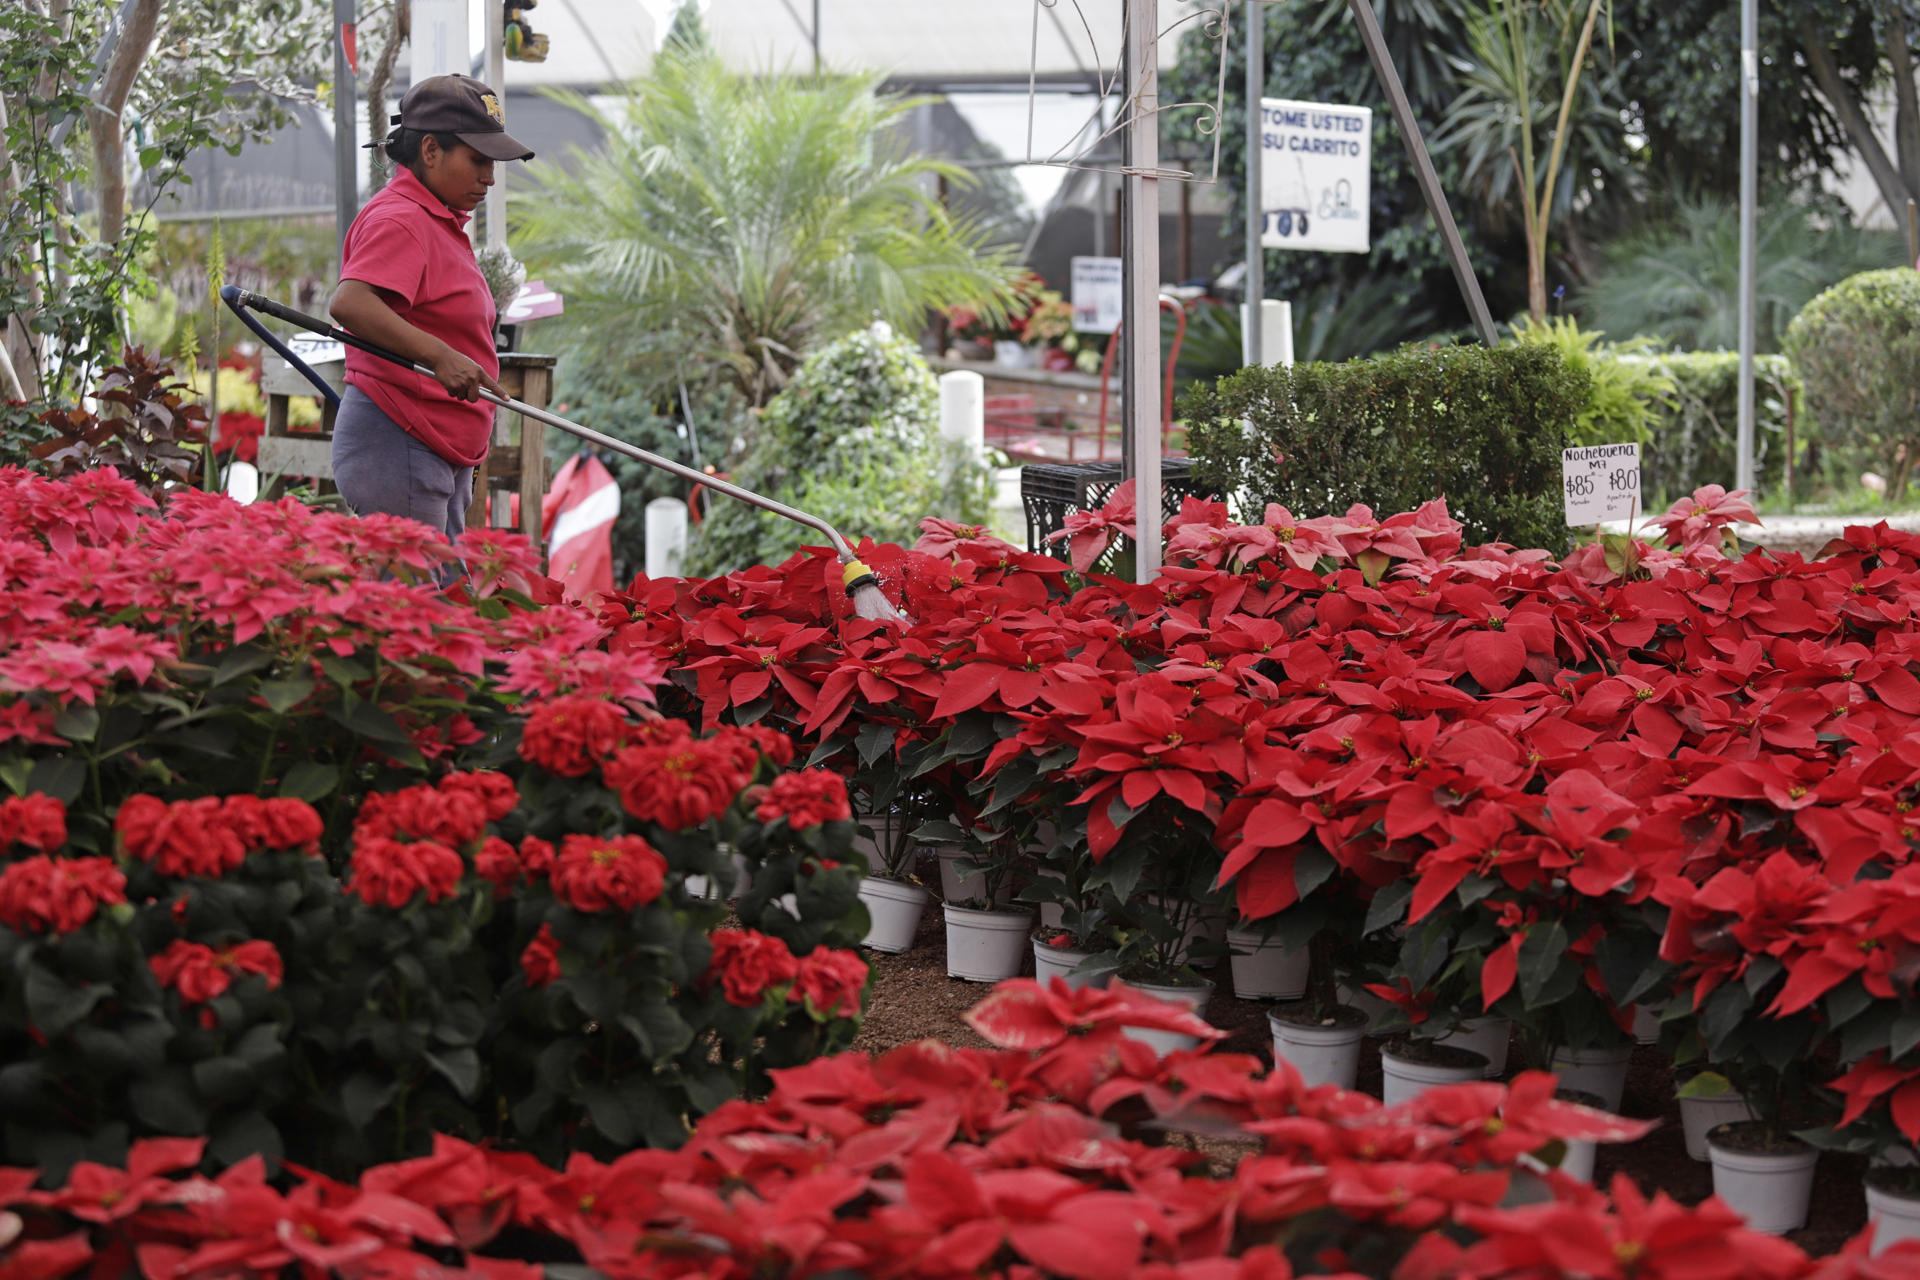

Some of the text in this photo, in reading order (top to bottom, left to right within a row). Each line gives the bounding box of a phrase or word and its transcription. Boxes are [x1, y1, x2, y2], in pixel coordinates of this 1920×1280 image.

[1261, 108, 1363, 132] TOME USTED
[1263, 133, 1360, 156] SU CARRITO
[1565, 445, 1636, 461] Nochebuena
